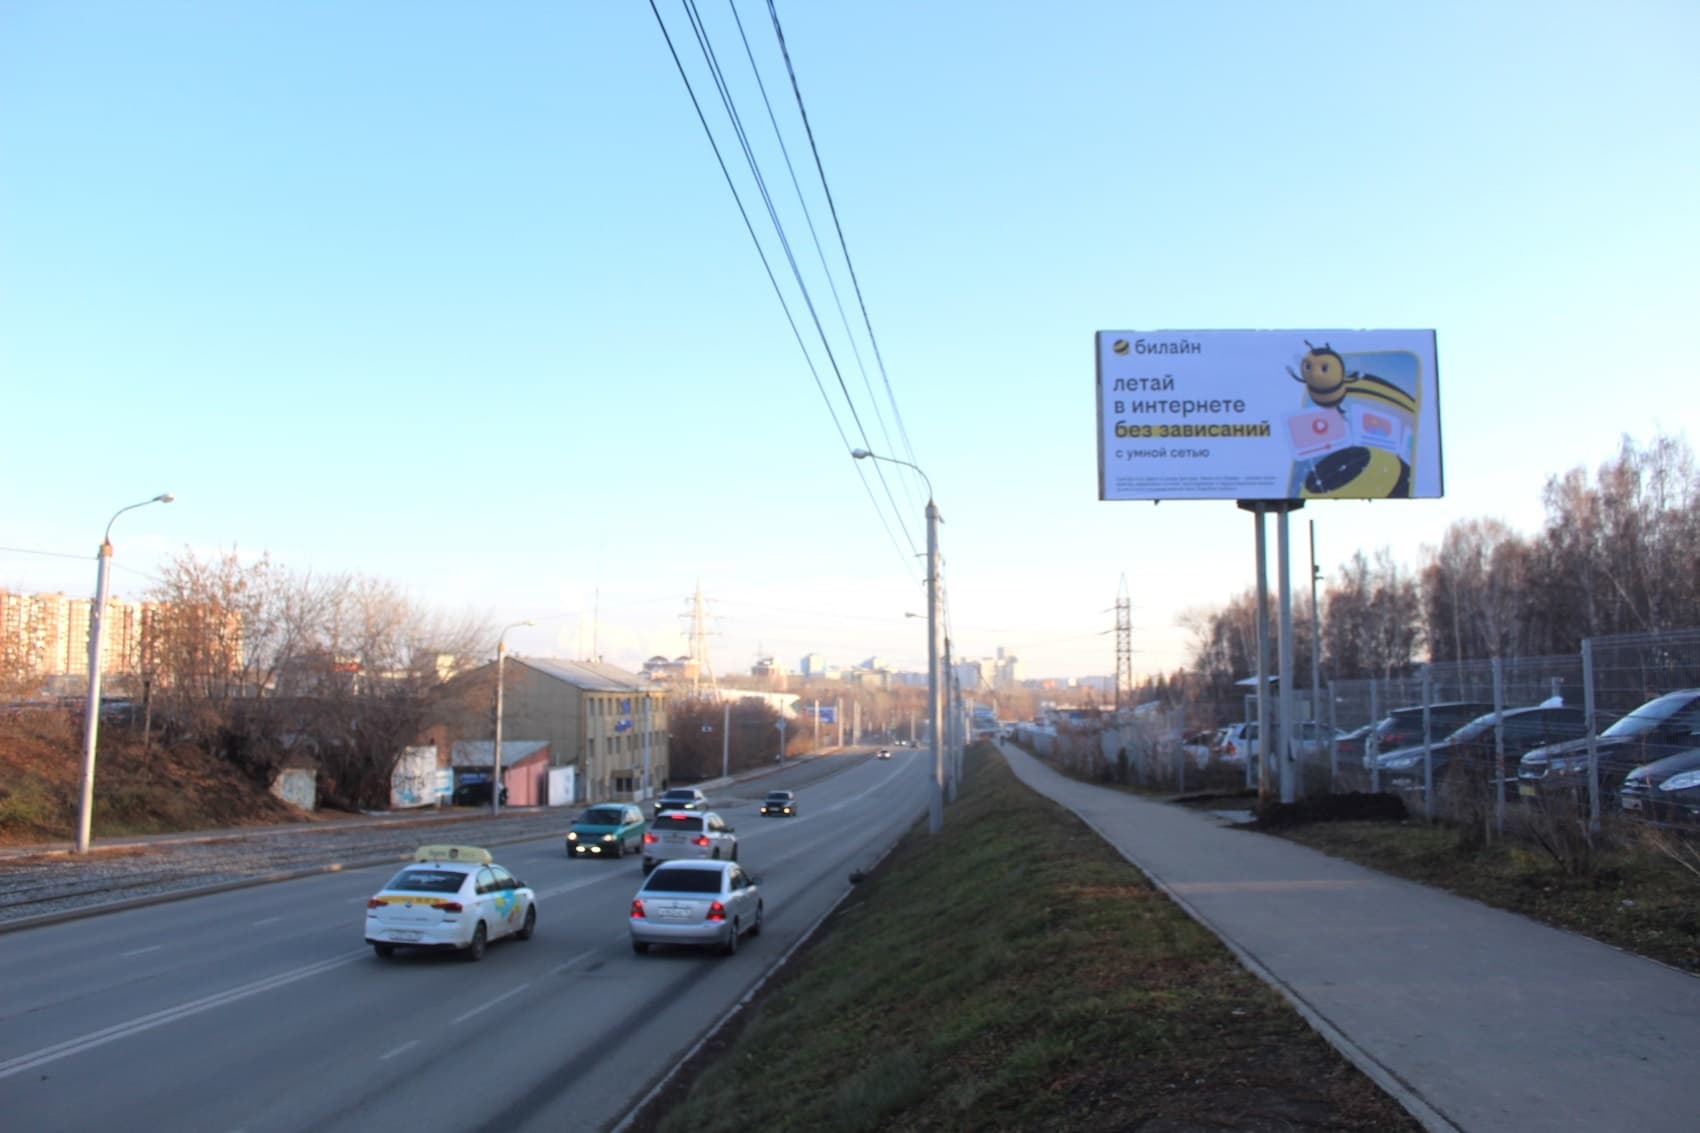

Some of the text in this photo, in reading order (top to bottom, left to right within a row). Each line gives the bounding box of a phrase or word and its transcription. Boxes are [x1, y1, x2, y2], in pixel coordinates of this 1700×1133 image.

[1134, 339, 1202, 355] билайн
[1113, 374, 1175, 391] летай
[1114, 399, 1246, 418] в интернете
[1114, 420, 1271, 438] без зависаний
[1115, 448, 1210, 460] с умной сетью
